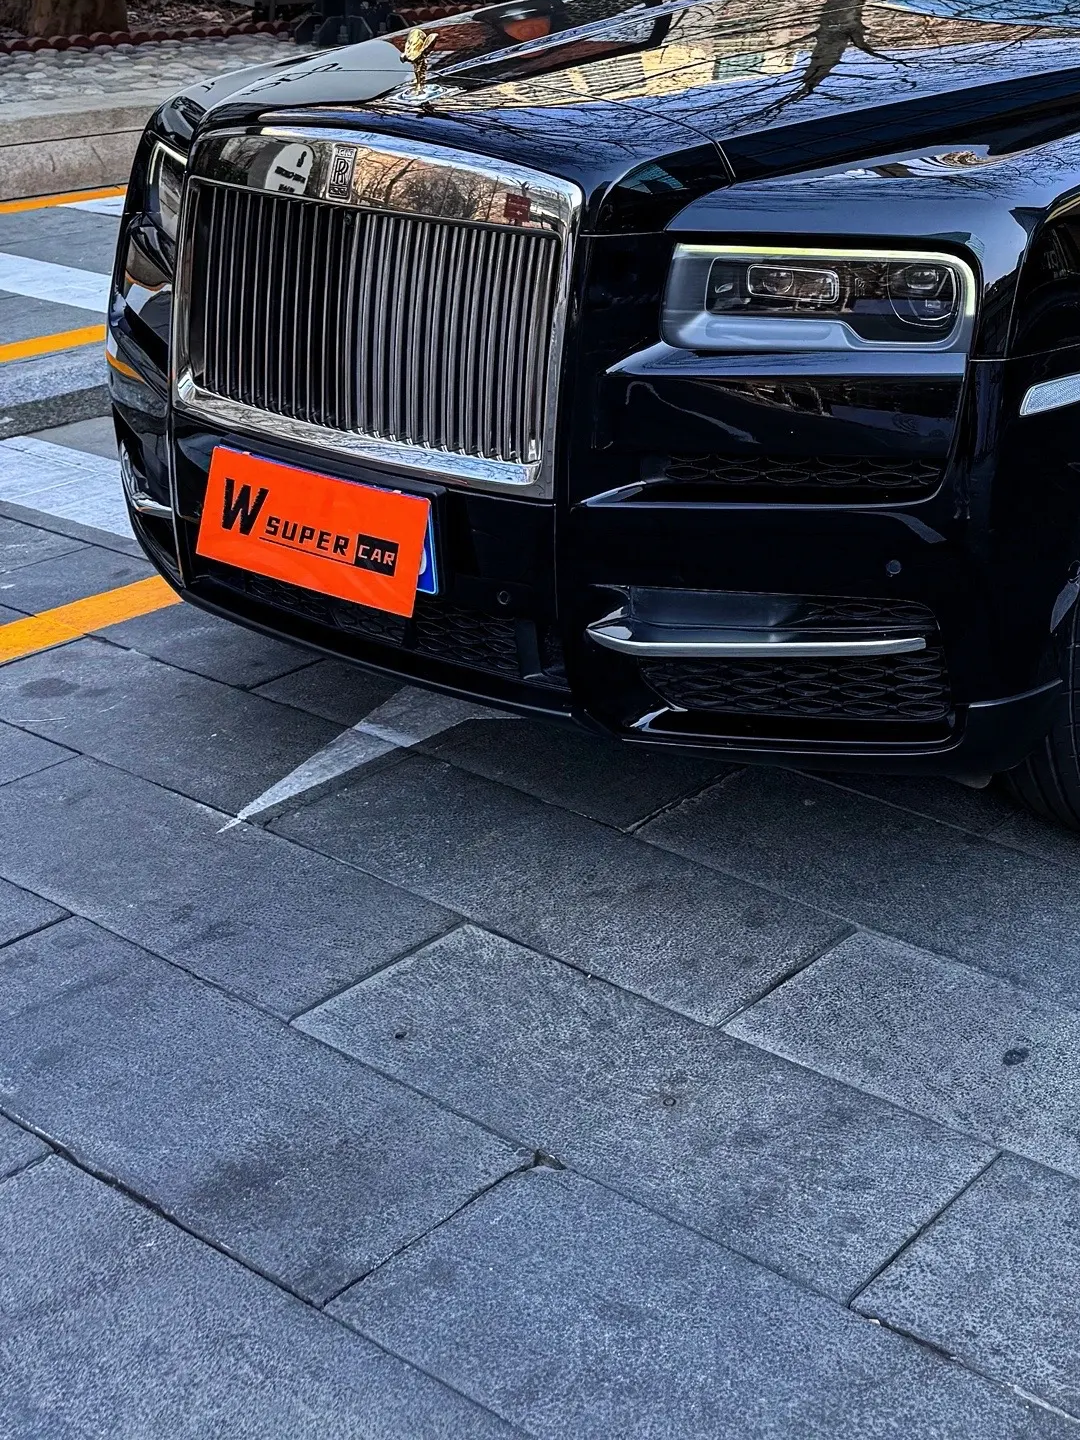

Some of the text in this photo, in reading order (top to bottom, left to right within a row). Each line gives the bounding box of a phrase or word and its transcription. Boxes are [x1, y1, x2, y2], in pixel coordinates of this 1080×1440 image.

[221, 477, 396, 566] W SUPER CAR
